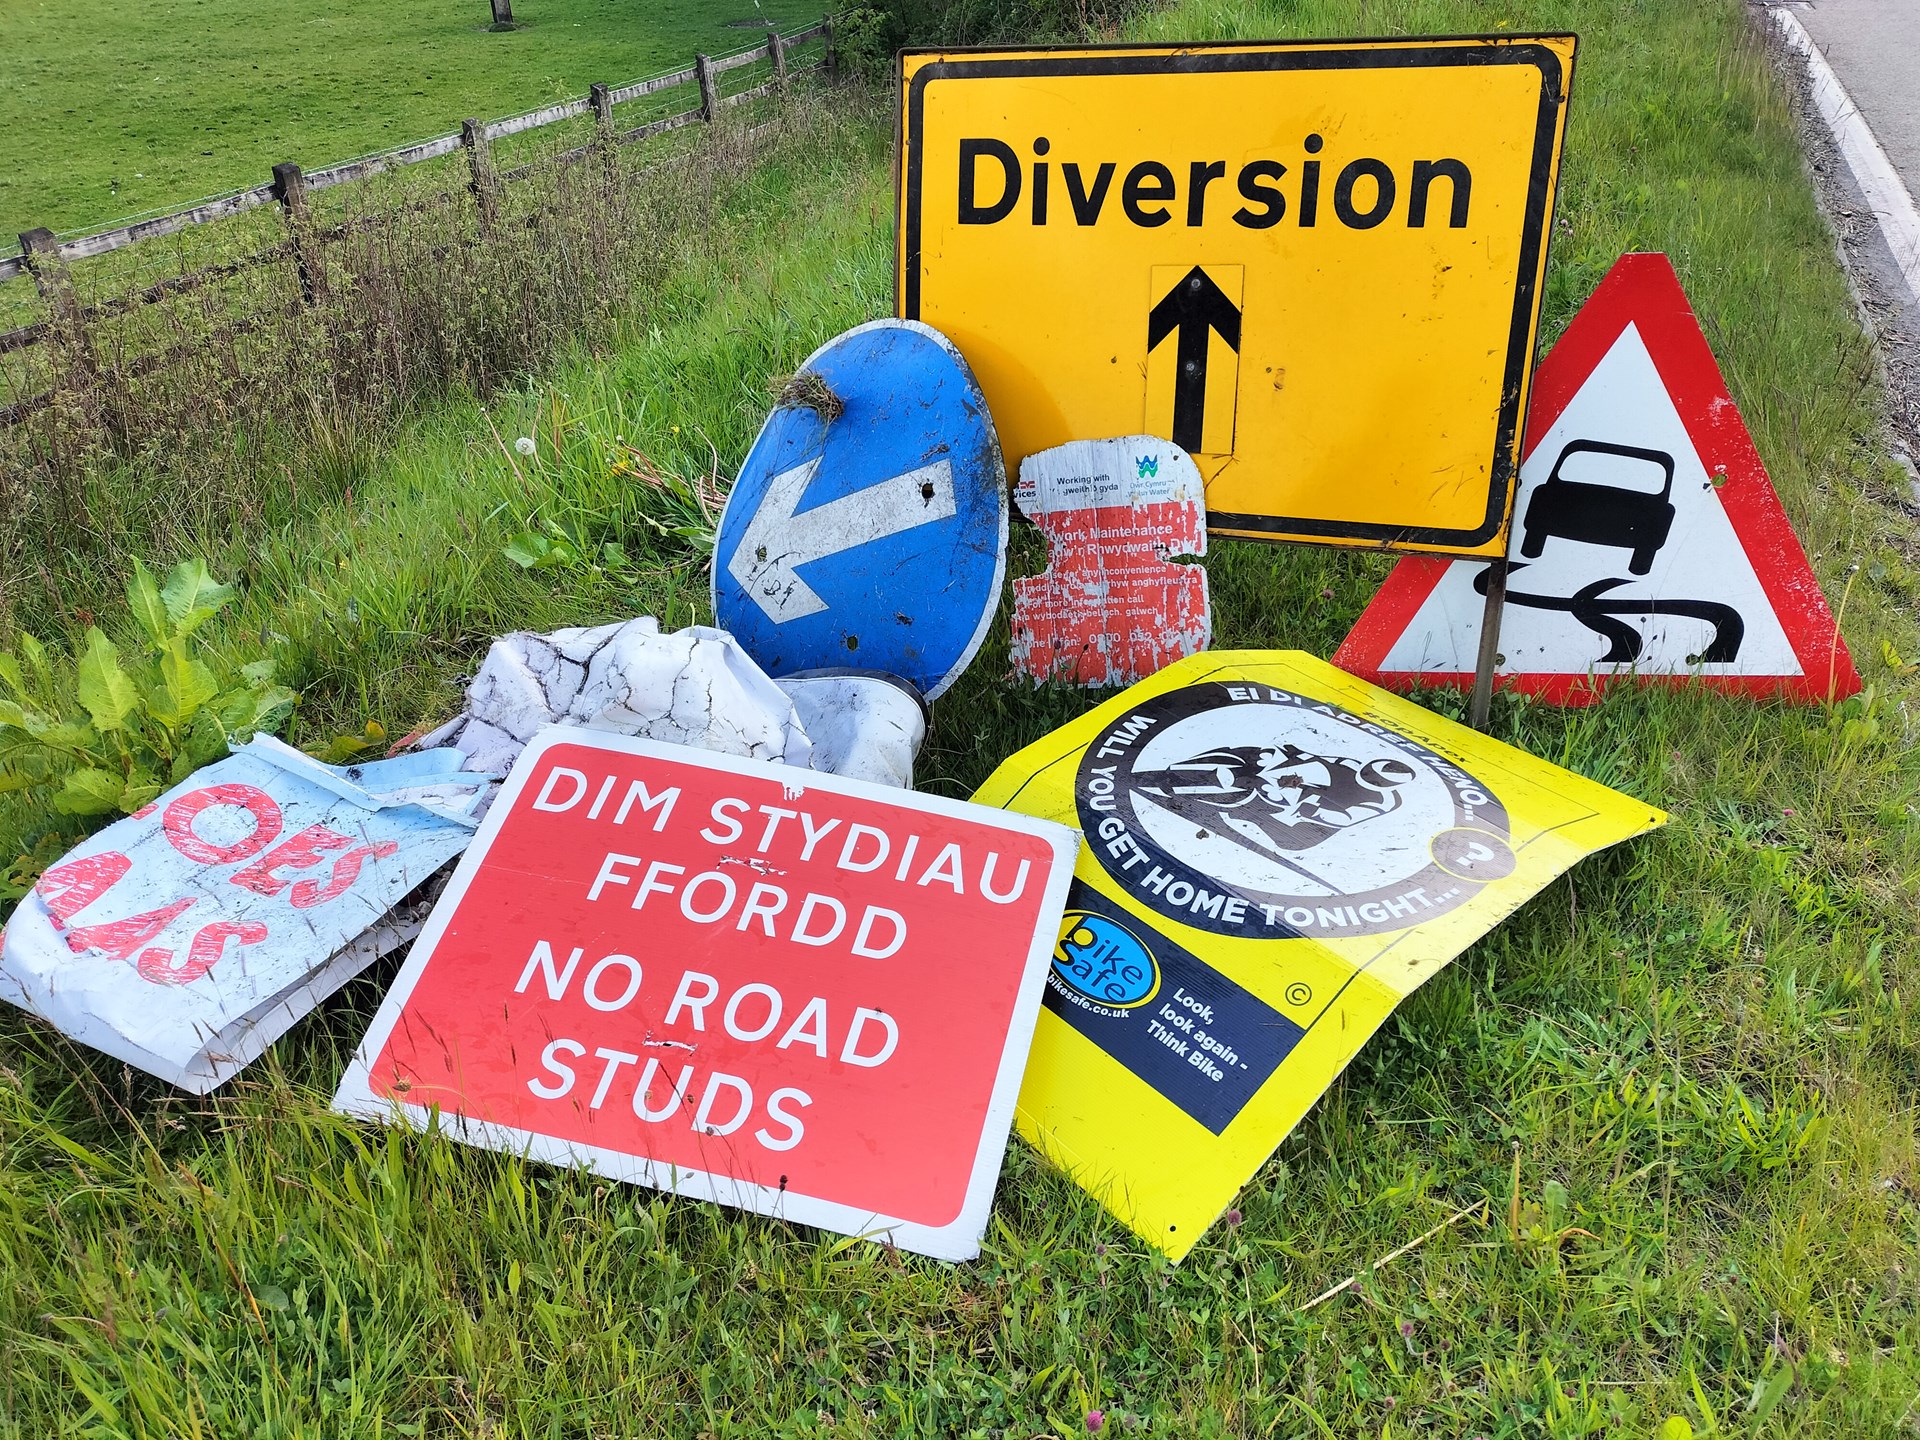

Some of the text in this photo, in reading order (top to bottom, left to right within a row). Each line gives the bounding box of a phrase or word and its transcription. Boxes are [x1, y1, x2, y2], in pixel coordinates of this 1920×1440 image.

[957, 133, 1472, 230] Diversion
[1056, 473, 1110, 485] Working with
[1099, 483, 1119, 493] gyda
[1090, 525, 1173, 539] Maintenance
[1099, 566, 1167, 575] nconvenience
[1125, 606, 1158, 616] galwch
[1127, 594, 1145, 603] call
[1096, 715, 1158, 758] WILL
[1226, 687, 1259, 701] EI
[1270, 690, 1302, 706] DI
[1311, 705, 1426, 752] ADREF
[1088, 765, 1118, 811] YOU
[532, 766, 1030, 904] DIM STYDIAU
[1098, 817, 1150, 871] GET
[587, 852, 907, 960] FFORDD
[1140, 865, 1250, 924] HOME
[1065, 915, 1143, 985] bike
[514, 940, 899, 1068] NO ROAD
[1047, 974, 1130, 1018] bikesafe.co.uk
[1173, 987, 1214, 1025] Look,
[1146, 1019, 1224, 1083] Think Bike
[1159, 1003, 1193, 1035] look
[1193, 1025, 1239, 1066] again
[527, 1039, 813, 1152] STUDS
